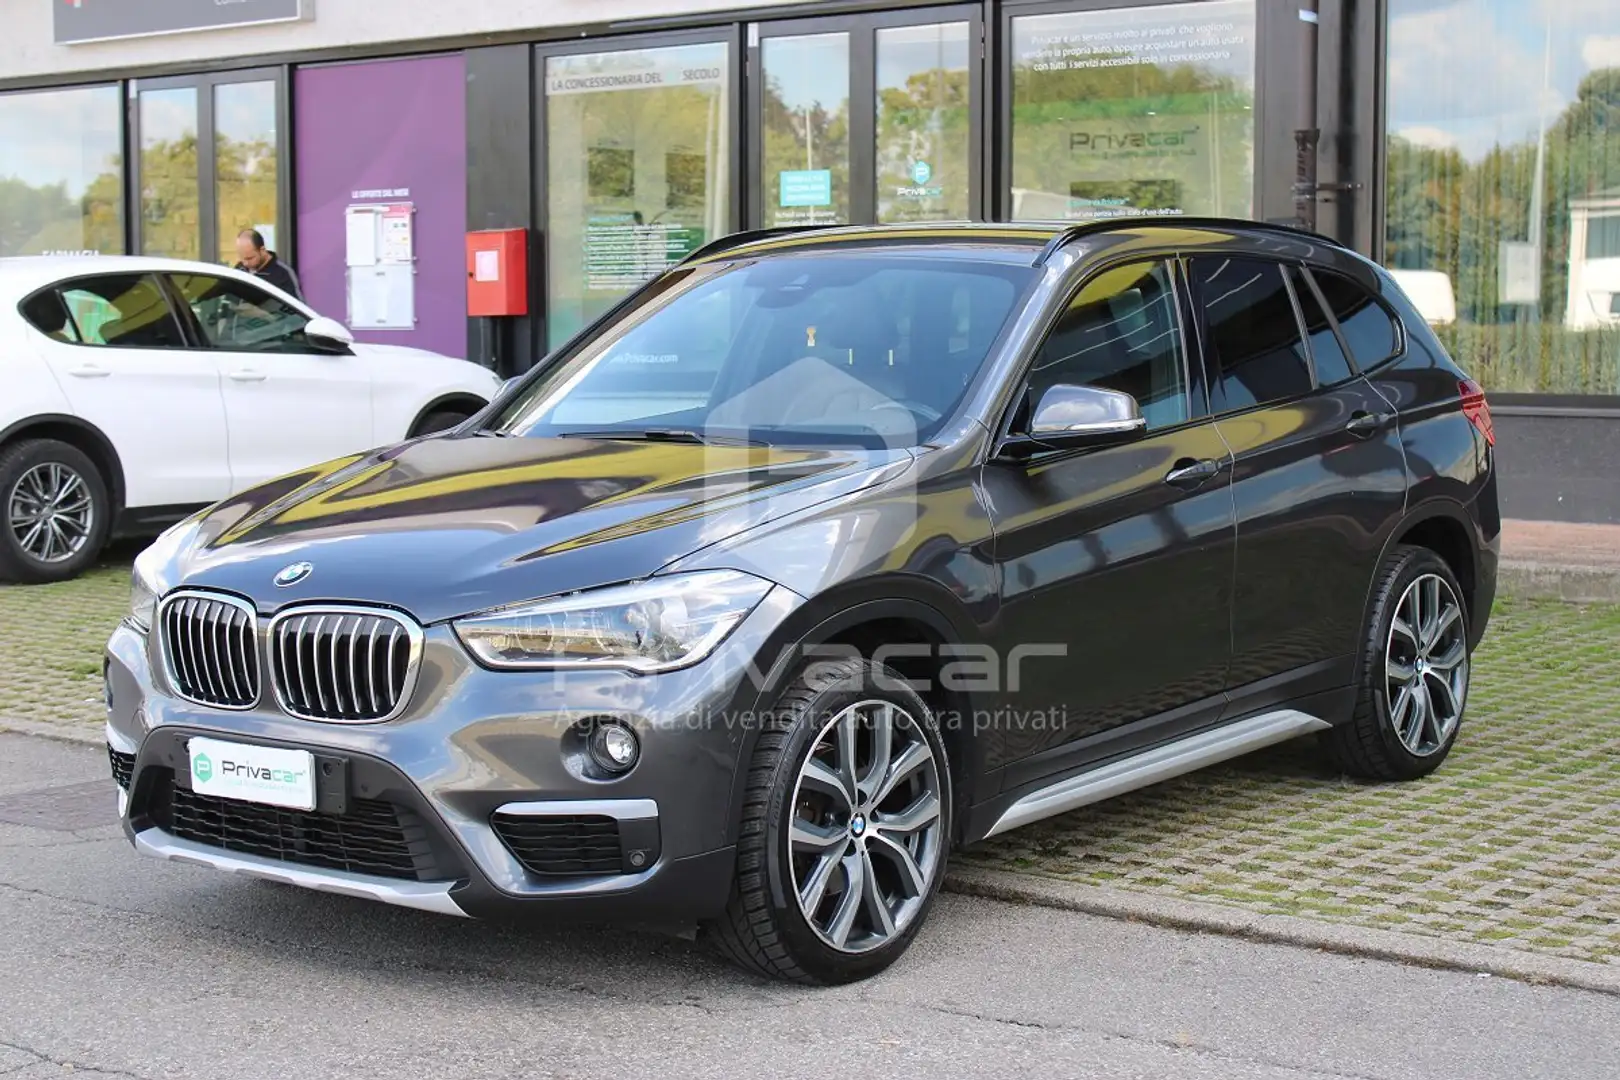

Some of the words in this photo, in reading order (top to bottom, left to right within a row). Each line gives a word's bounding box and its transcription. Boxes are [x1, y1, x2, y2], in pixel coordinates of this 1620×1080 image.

[1033, 62, 1049, 72] con
[1050, 61, 1067, 71] tutti
[1073, 57, 1099, 69] servizi
[1100, 55, 1140, 67] accessibili
[1140, 54, 1158, 65] solo
[552, 79, 564, 91] LA
[564, 73, 644, 90] CONCESSIONARIA
[644, 72, 663, 84] DEL
[683, 67, 720, 81] SECOLO
[1070, 127, 1199, 150] Privacar
[222, 760, 306, 784] Privacar
